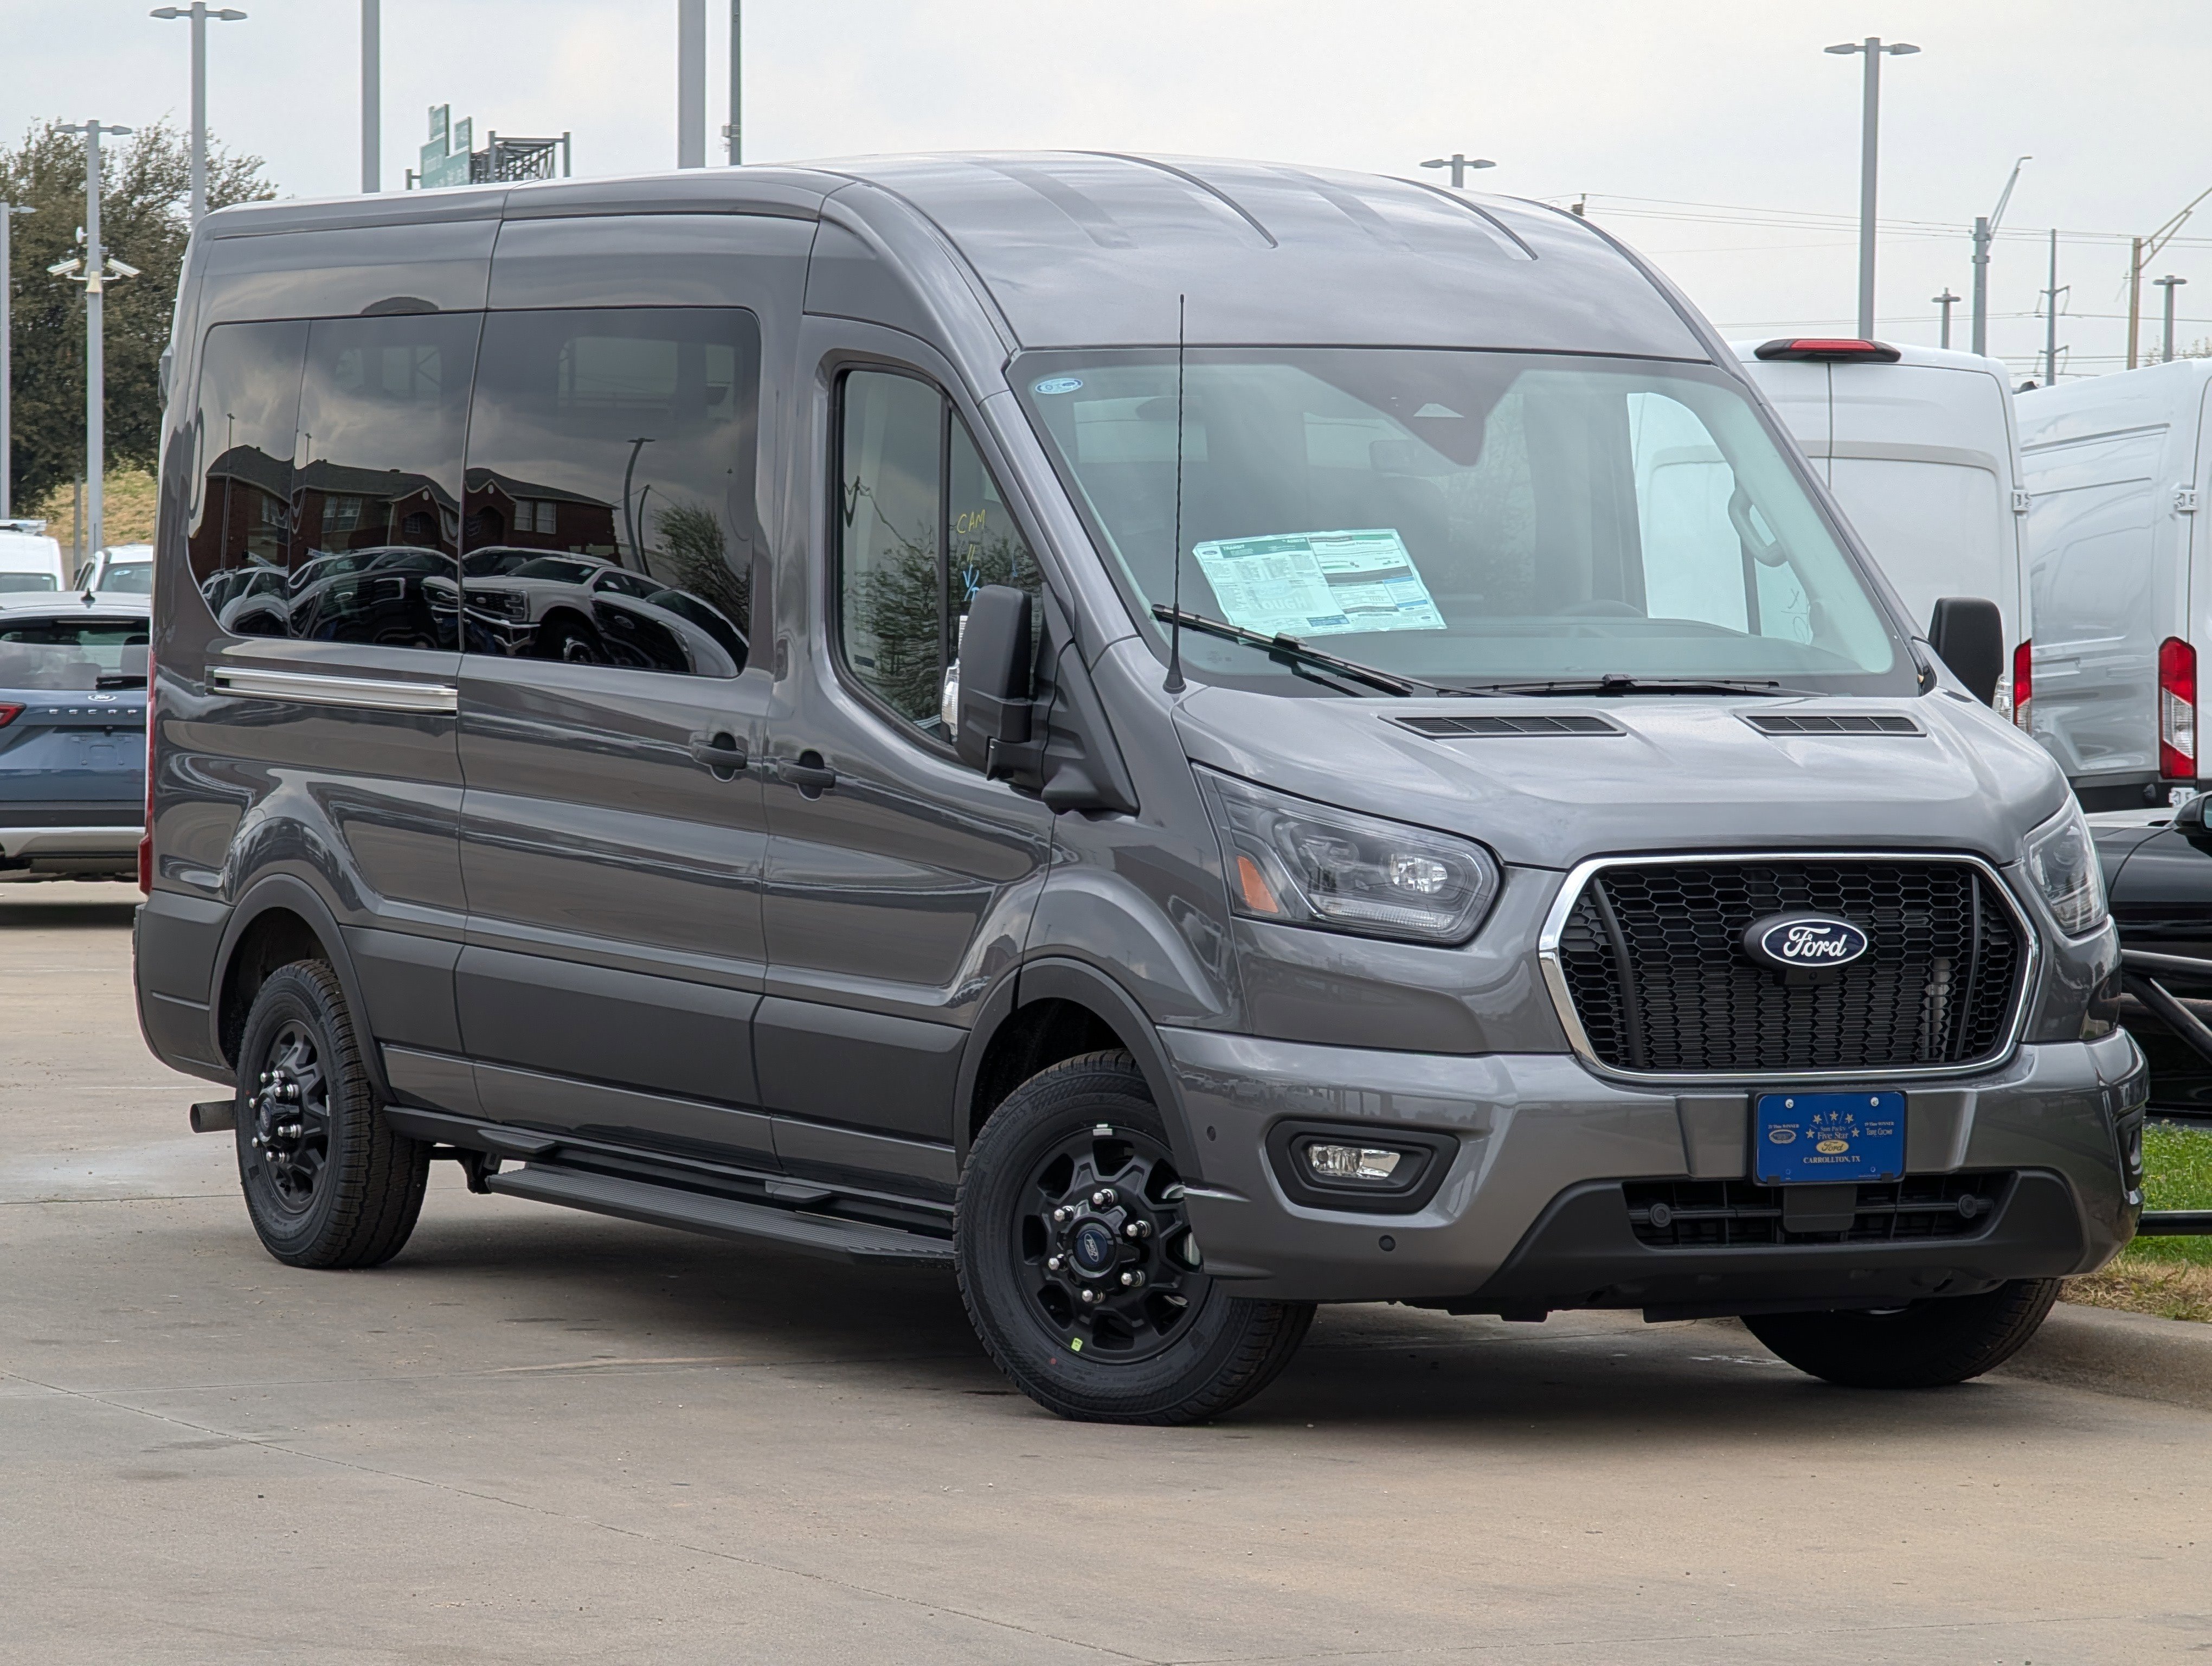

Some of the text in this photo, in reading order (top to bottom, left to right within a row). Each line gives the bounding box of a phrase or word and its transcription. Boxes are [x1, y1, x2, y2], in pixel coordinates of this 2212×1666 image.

[957, 509, 986, 533] CAM
[1783, 926, 1848, 957] Ford
[1818, 1132, 1832, 1140] Five
[1821, 1140, 1844, 1152] Ford
[1803, 1156, 1850, 1164] CARROLLTON,
